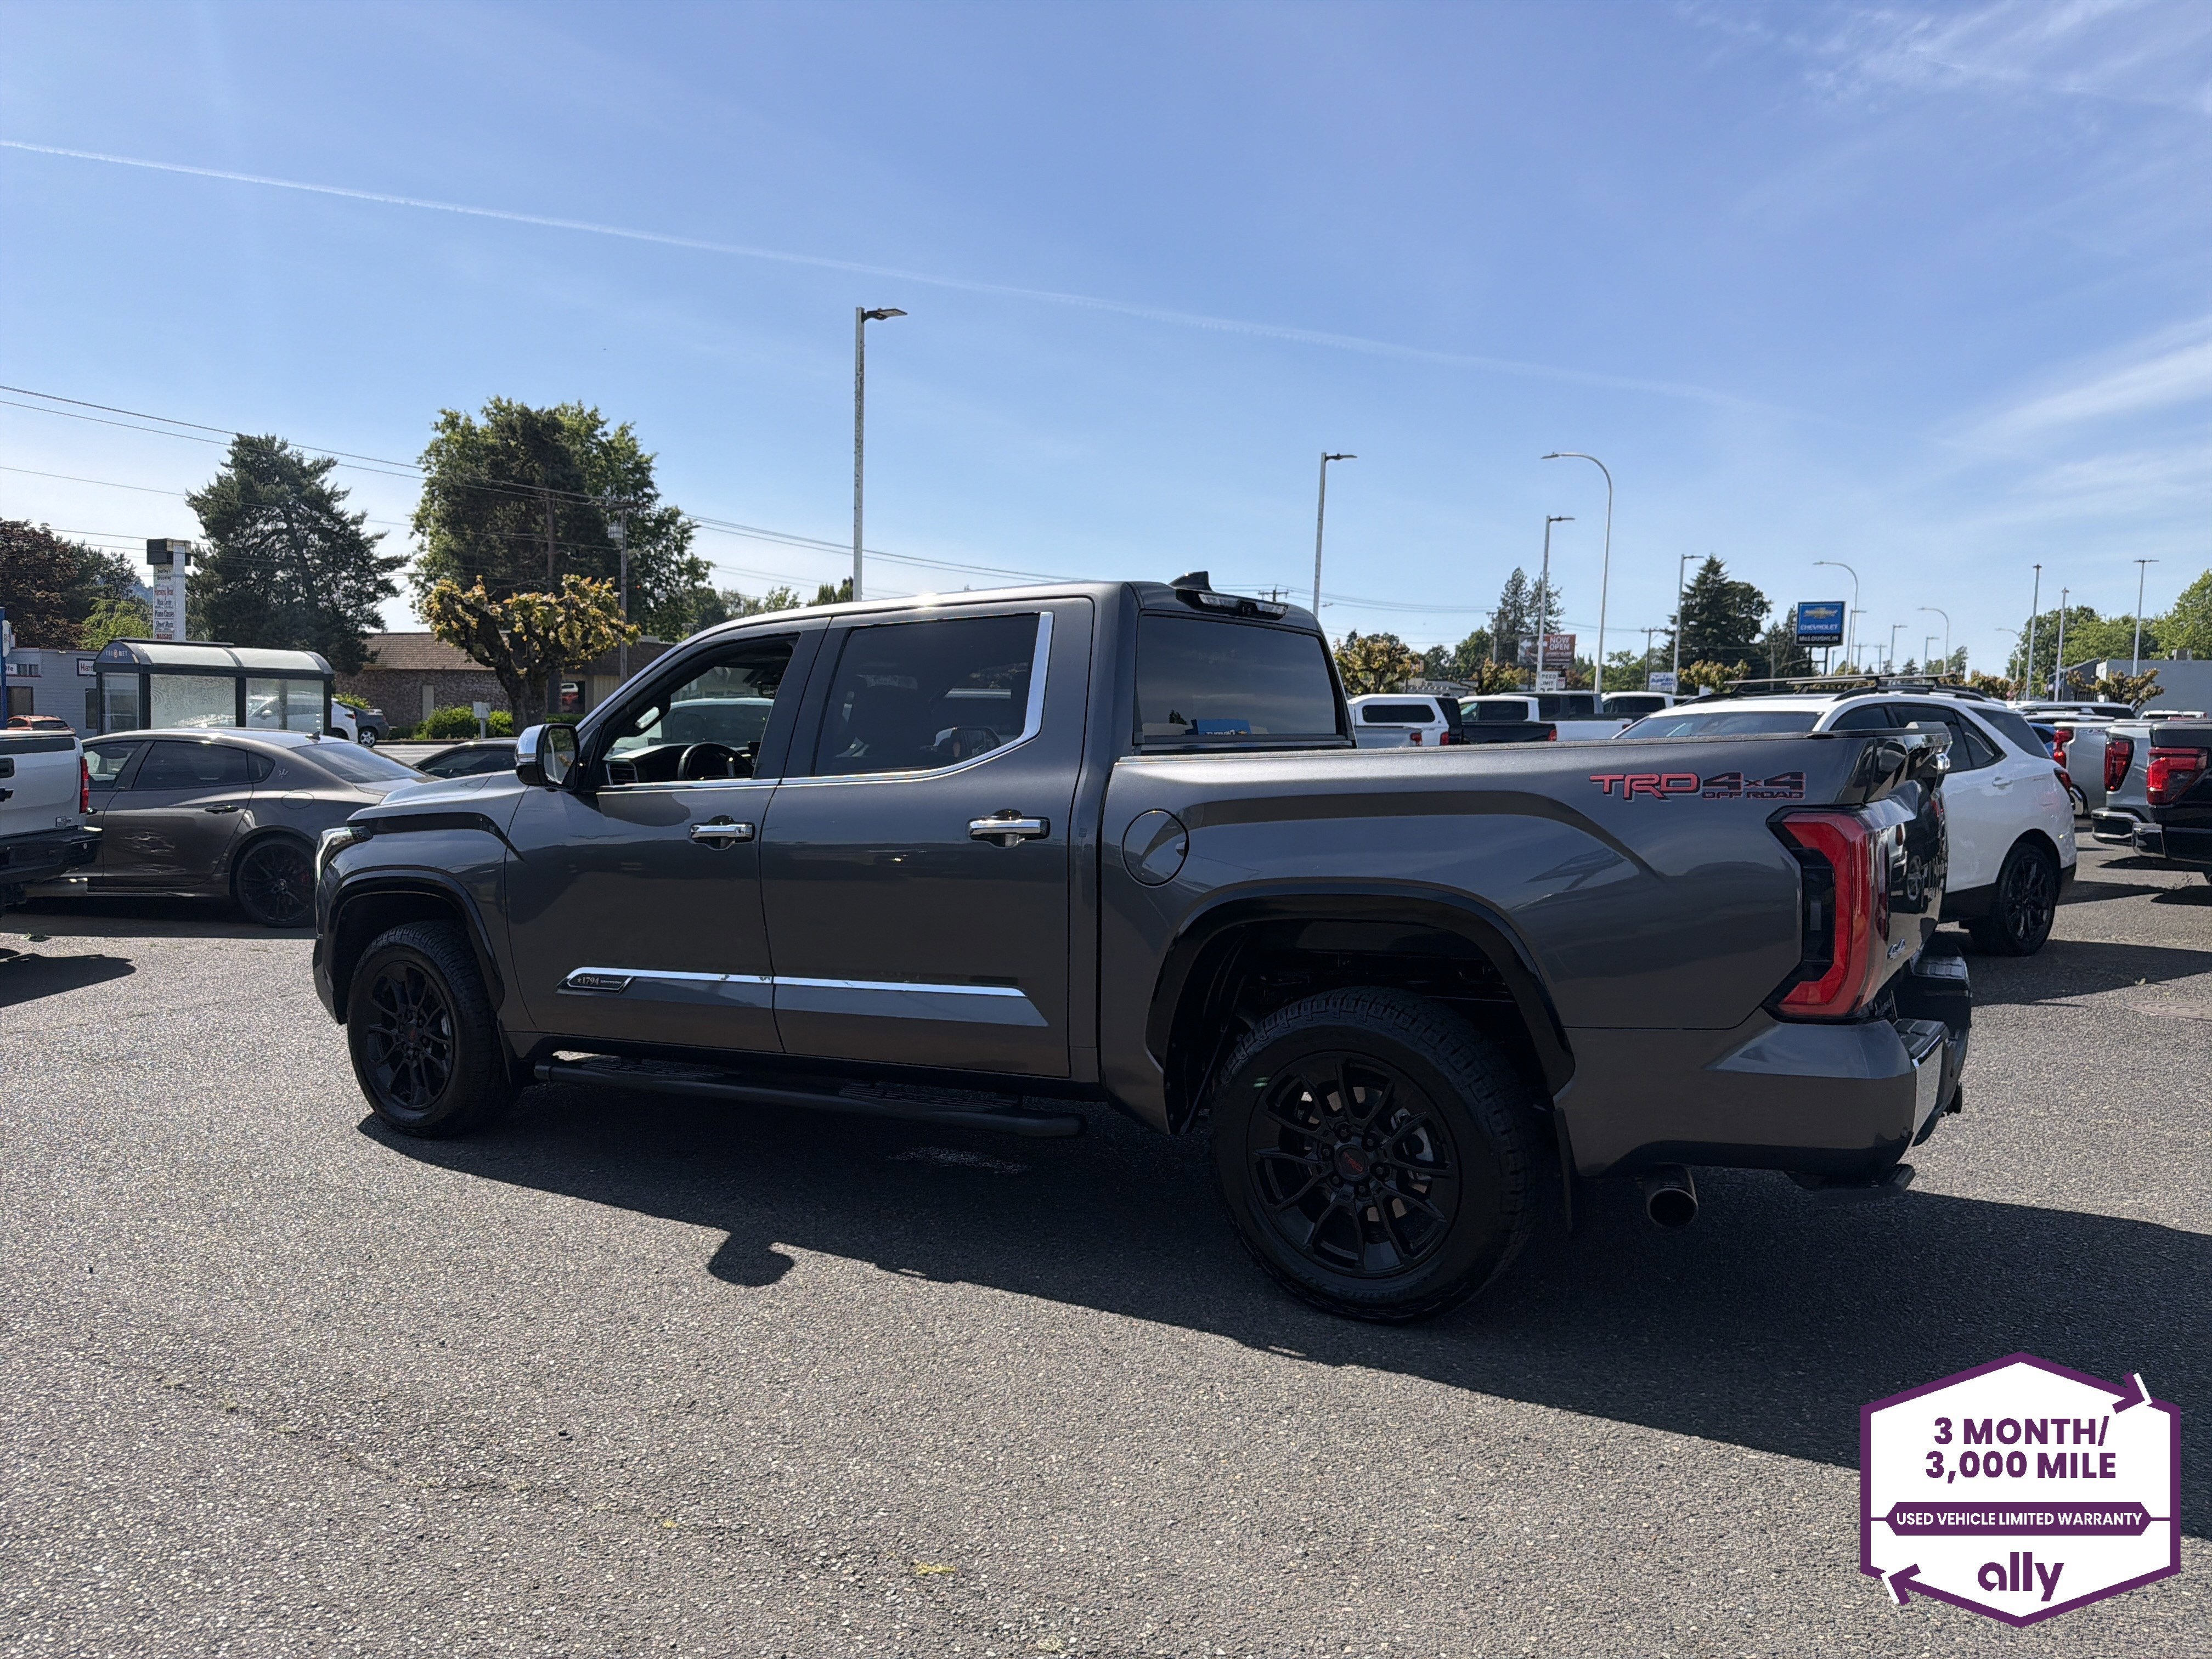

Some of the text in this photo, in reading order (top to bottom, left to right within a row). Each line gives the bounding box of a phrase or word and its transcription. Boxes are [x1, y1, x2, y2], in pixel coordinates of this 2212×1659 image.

[1589, 771, 1805, 800] TRD 4x4
[1702, 791, 1805, 799] OFF ROAD
[583, 977, 600, 985] 1794
